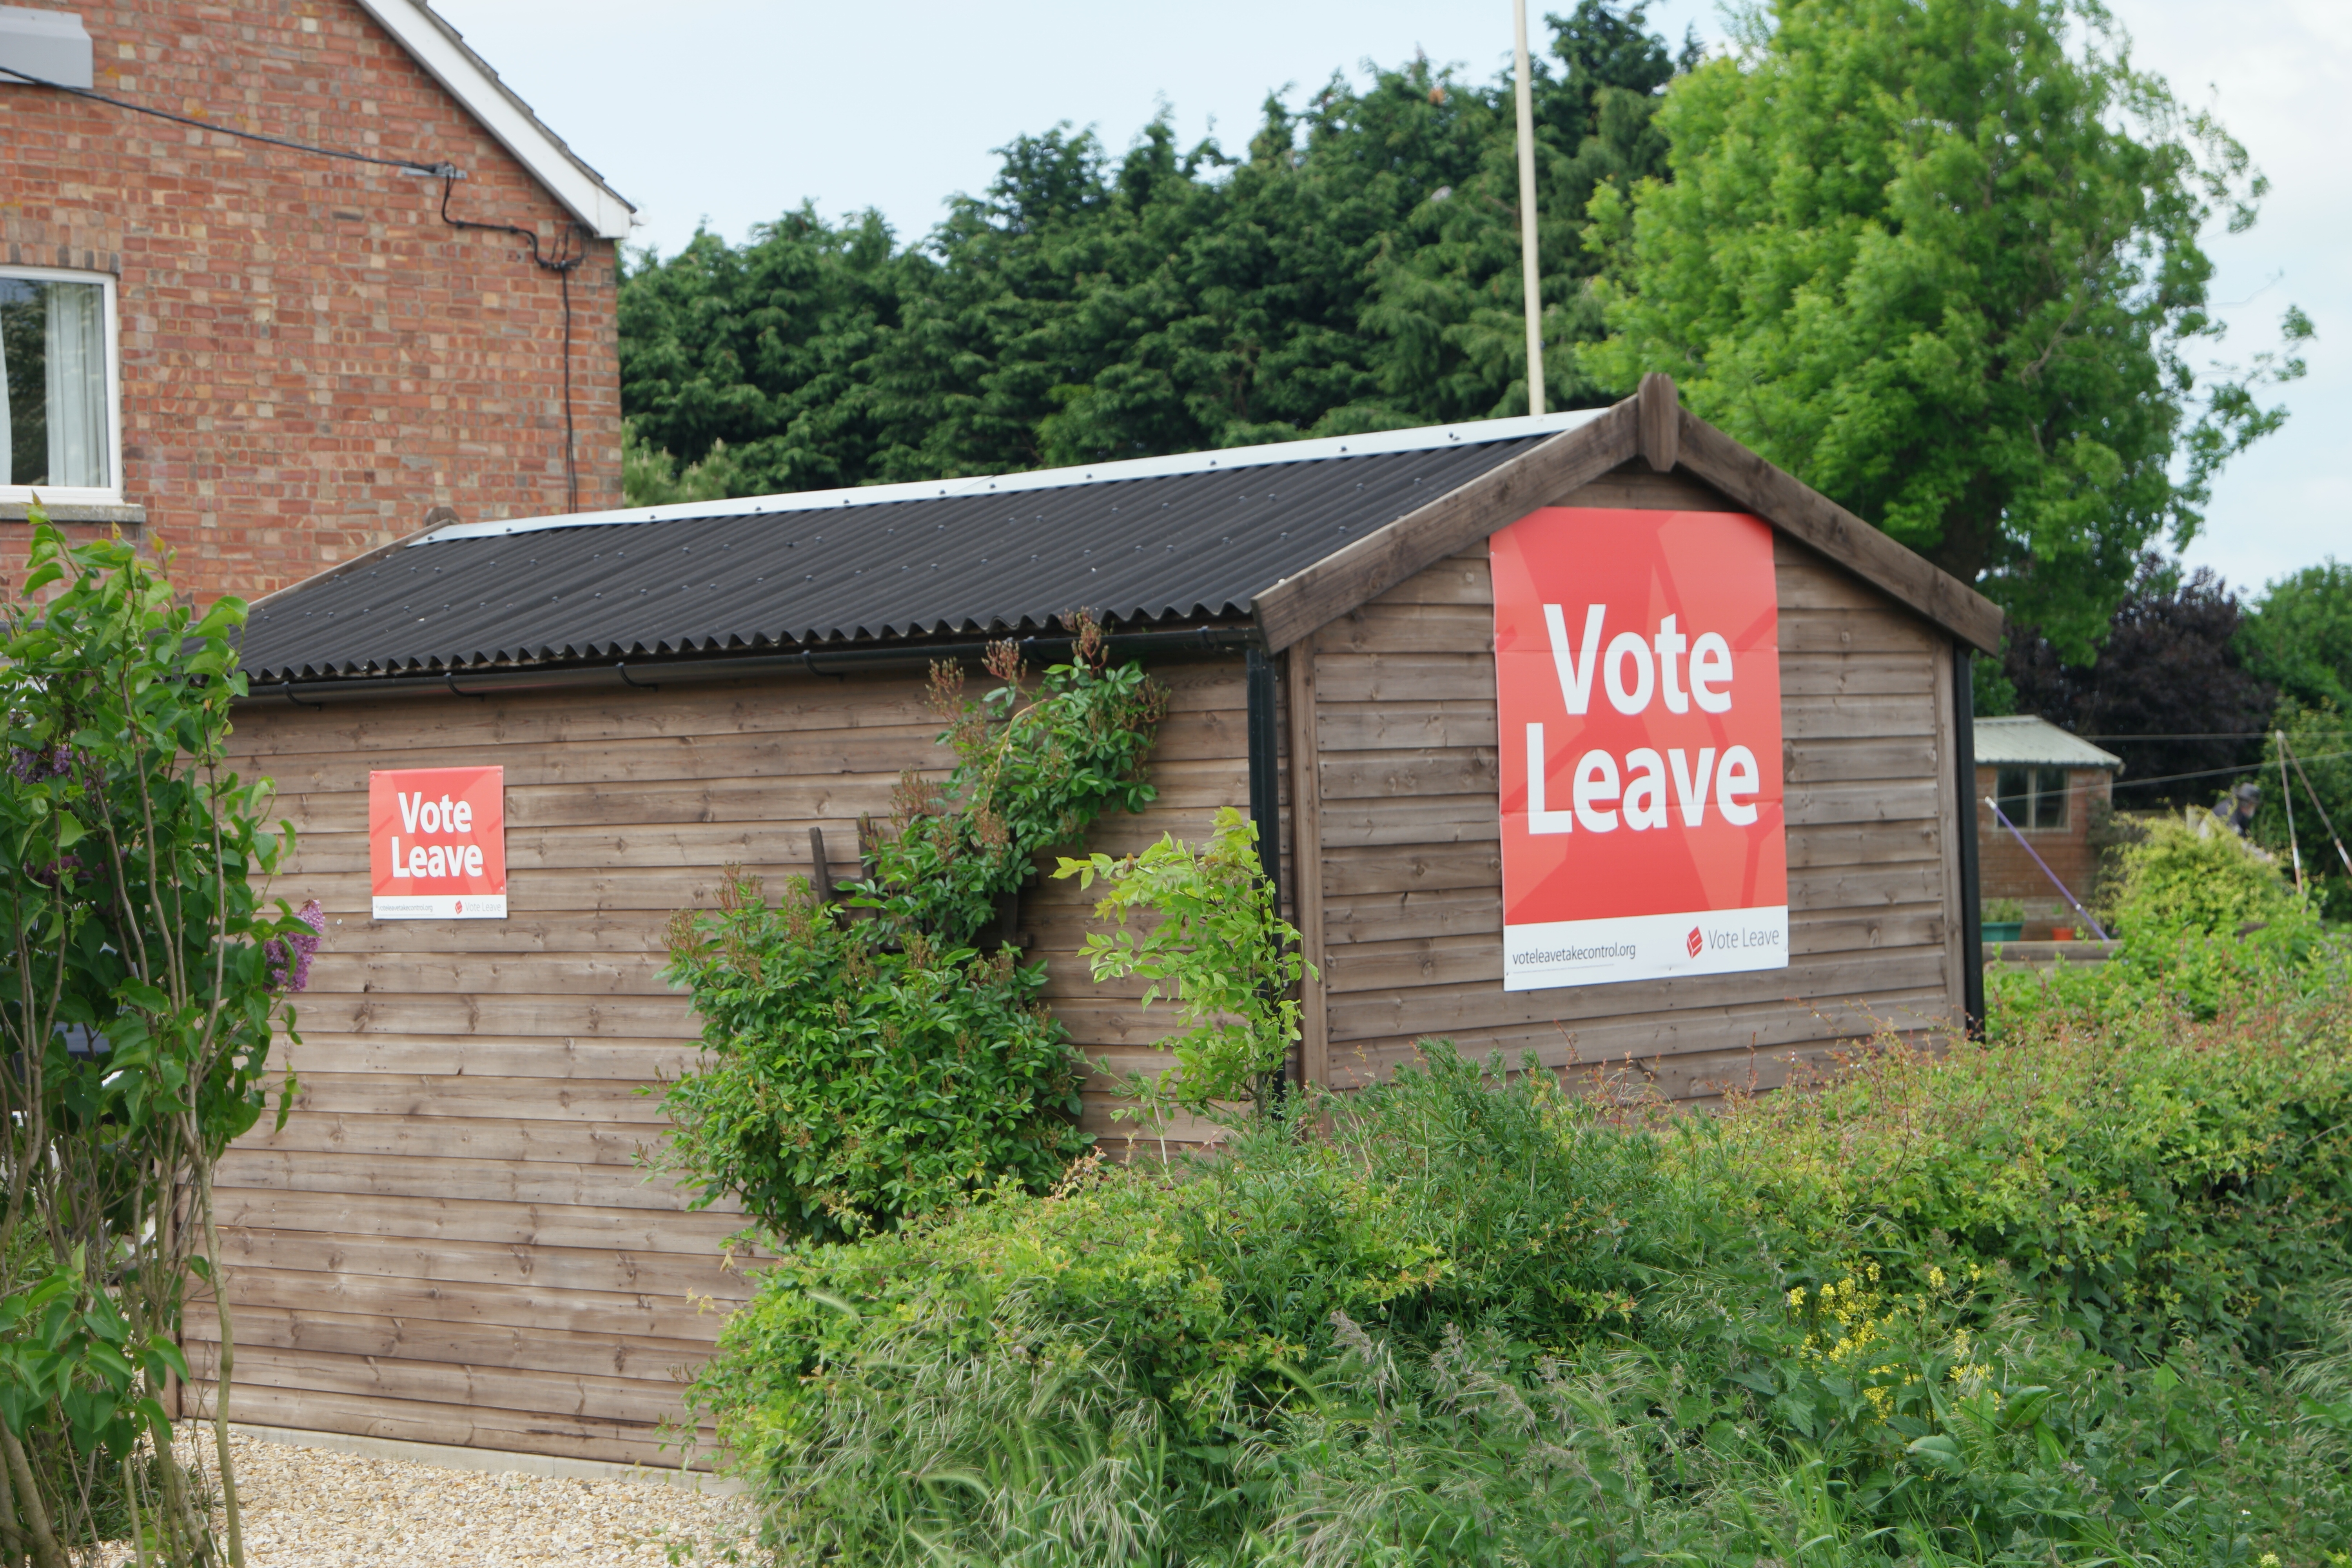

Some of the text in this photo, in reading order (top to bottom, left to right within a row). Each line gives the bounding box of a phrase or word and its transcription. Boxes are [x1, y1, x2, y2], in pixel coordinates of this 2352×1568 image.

[1543, 604, 1733, 715] Vote
[1526, 722, 1759, 835] Leave
[397, 791, 472, 834] Vote
[391, 836, 484, 878] Leave
[465, 902, 501, 912] Vote Leave
[1512, 942, 1636, 965] voteleavetakecontrol.org
[1708, 927, 1779, 949] Vote Leave
